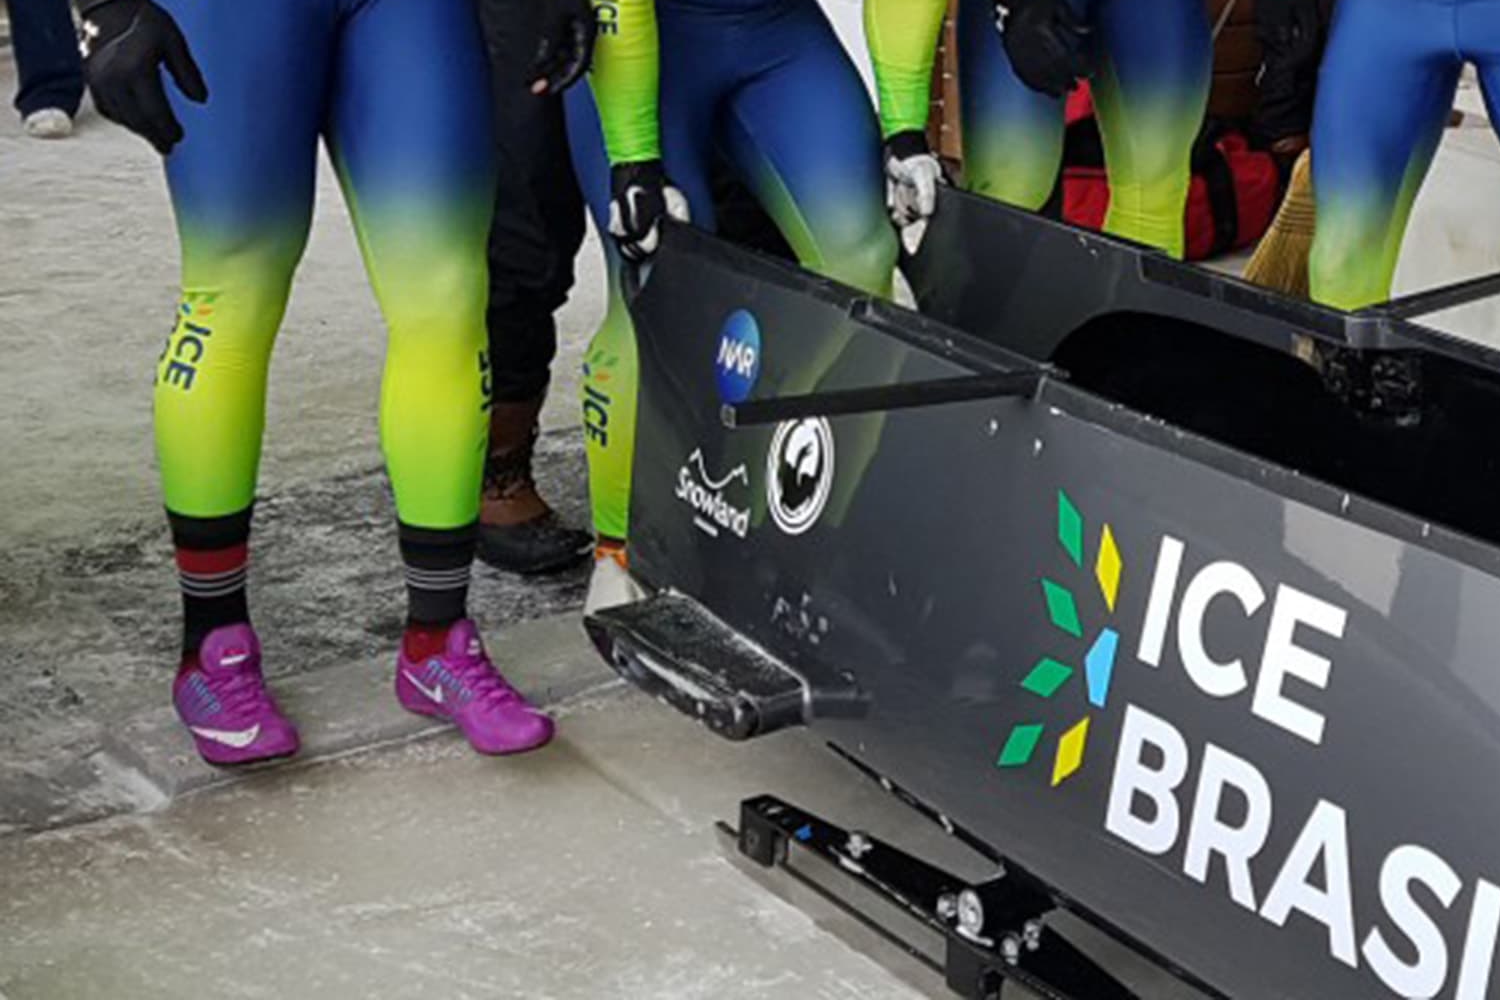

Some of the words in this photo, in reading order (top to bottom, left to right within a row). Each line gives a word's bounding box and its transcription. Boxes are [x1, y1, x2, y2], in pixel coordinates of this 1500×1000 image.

[163, 321, 212, 391] ICE
[582, 384, 611, 448] ICE
[675, 466, 751, 539] Snowland
[1136, 534, 1348, 745] ICE
